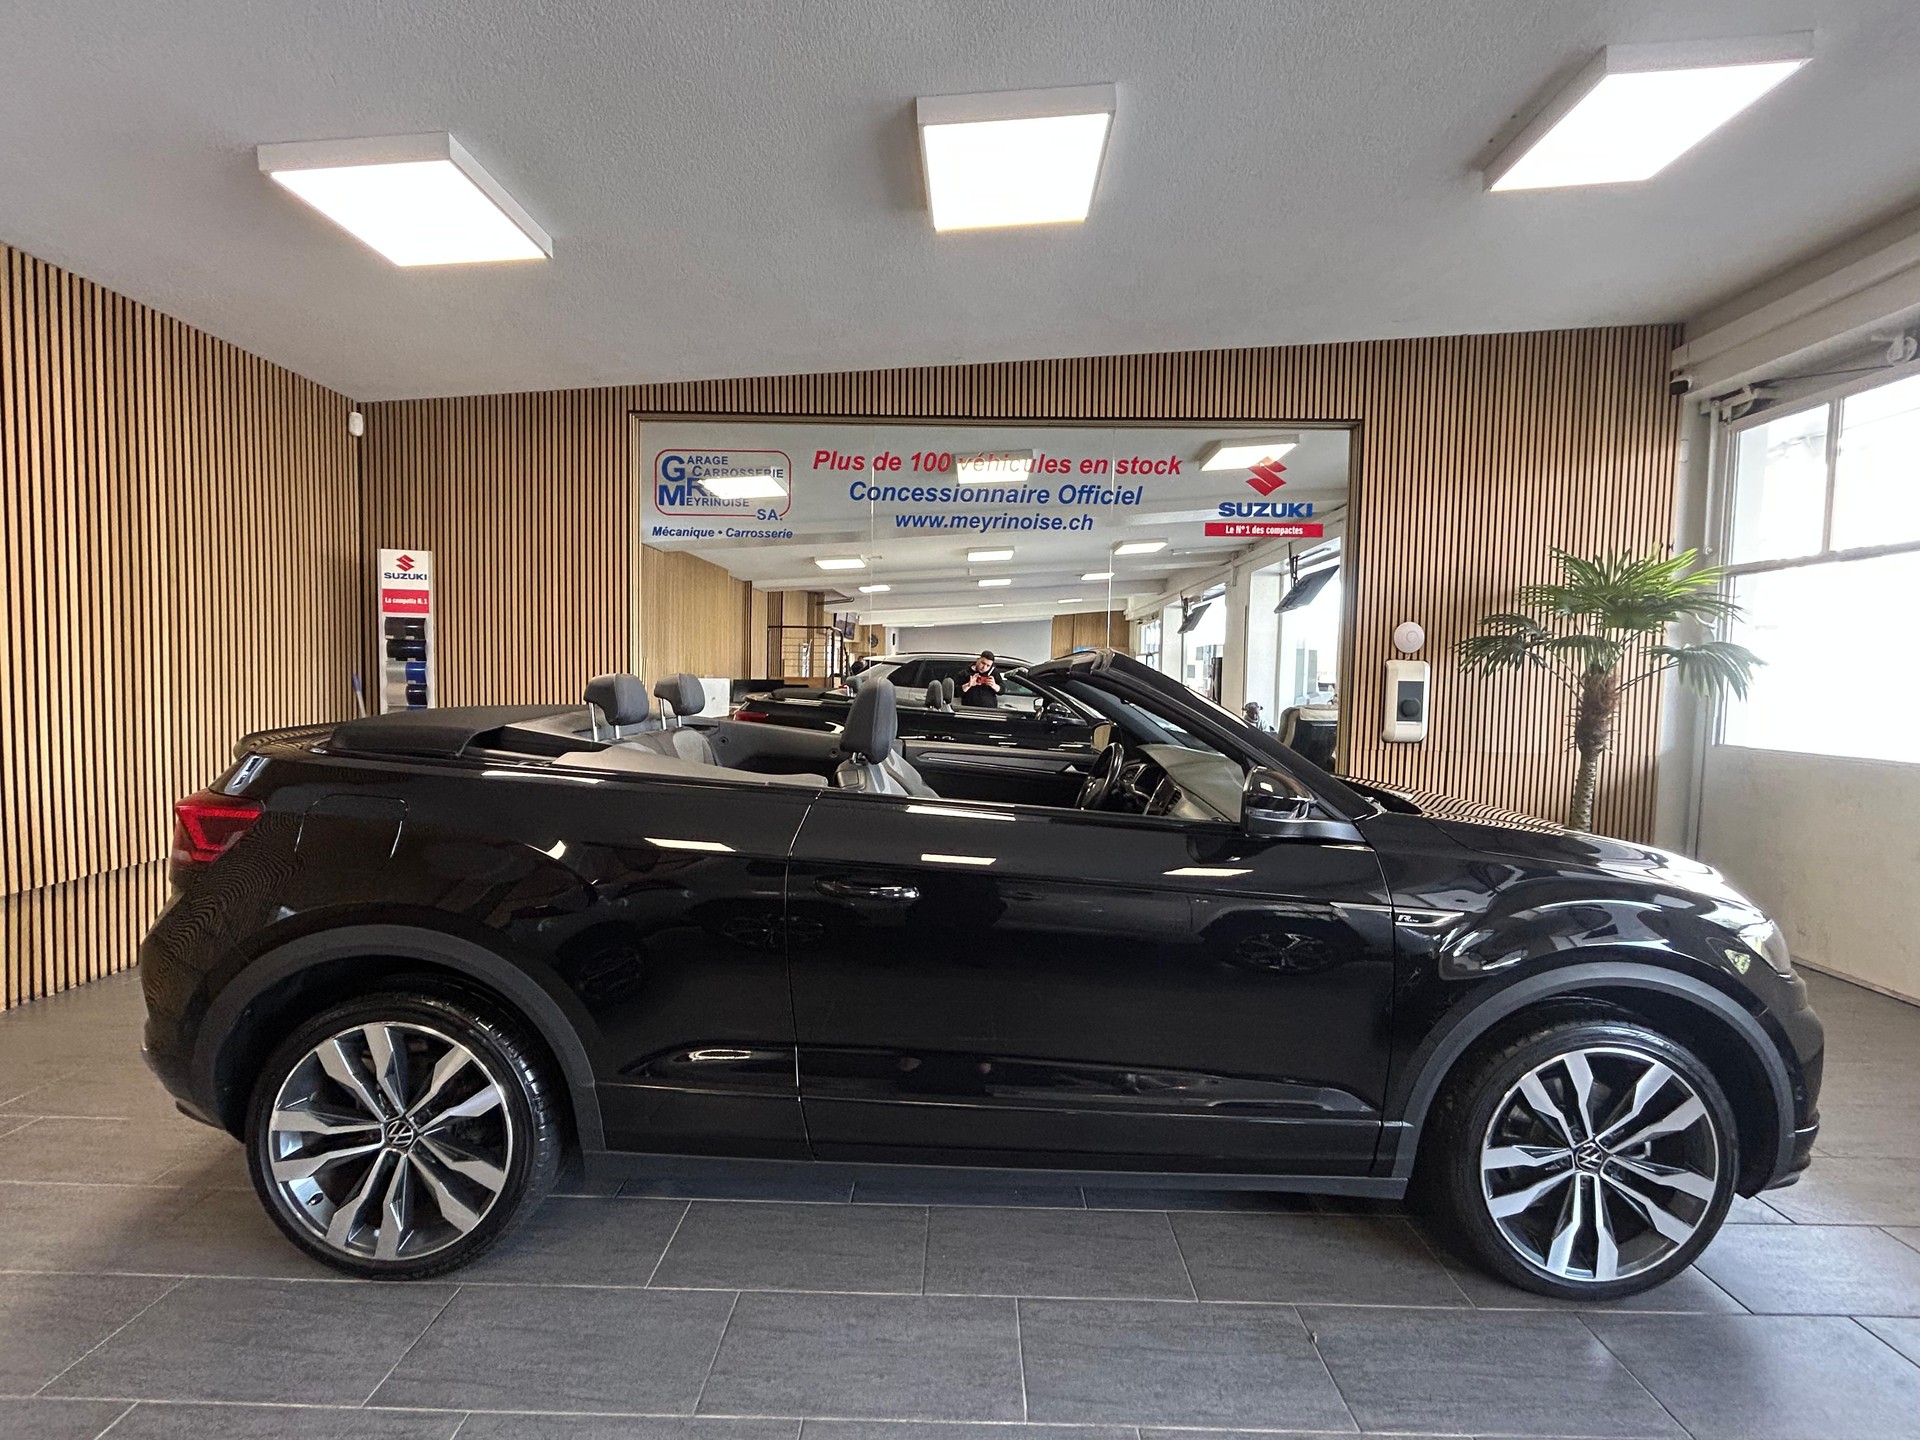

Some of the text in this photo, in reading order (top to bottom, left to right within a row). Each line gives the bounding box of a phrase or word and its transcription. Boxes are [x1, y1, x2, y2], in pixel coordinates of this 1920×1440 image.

[813, 450, 1182, 475] Plus de 100 véhicules en stock
[849, 481, 1143, 505] Concessionnaire Officiel
[1218, 502, 1313, 518] SUZUKI
[895, 513, 1094, 533] www.meyrinoise.ch
[1225, 525, 1234, 533] Le
[1252, 525, 1264, 534] des
[1266, 526, 1303, 535] compactes
[652, 526, 793, 539] Mécanique Carrosserie
[384, 572, 427, 580] SUZUKI
